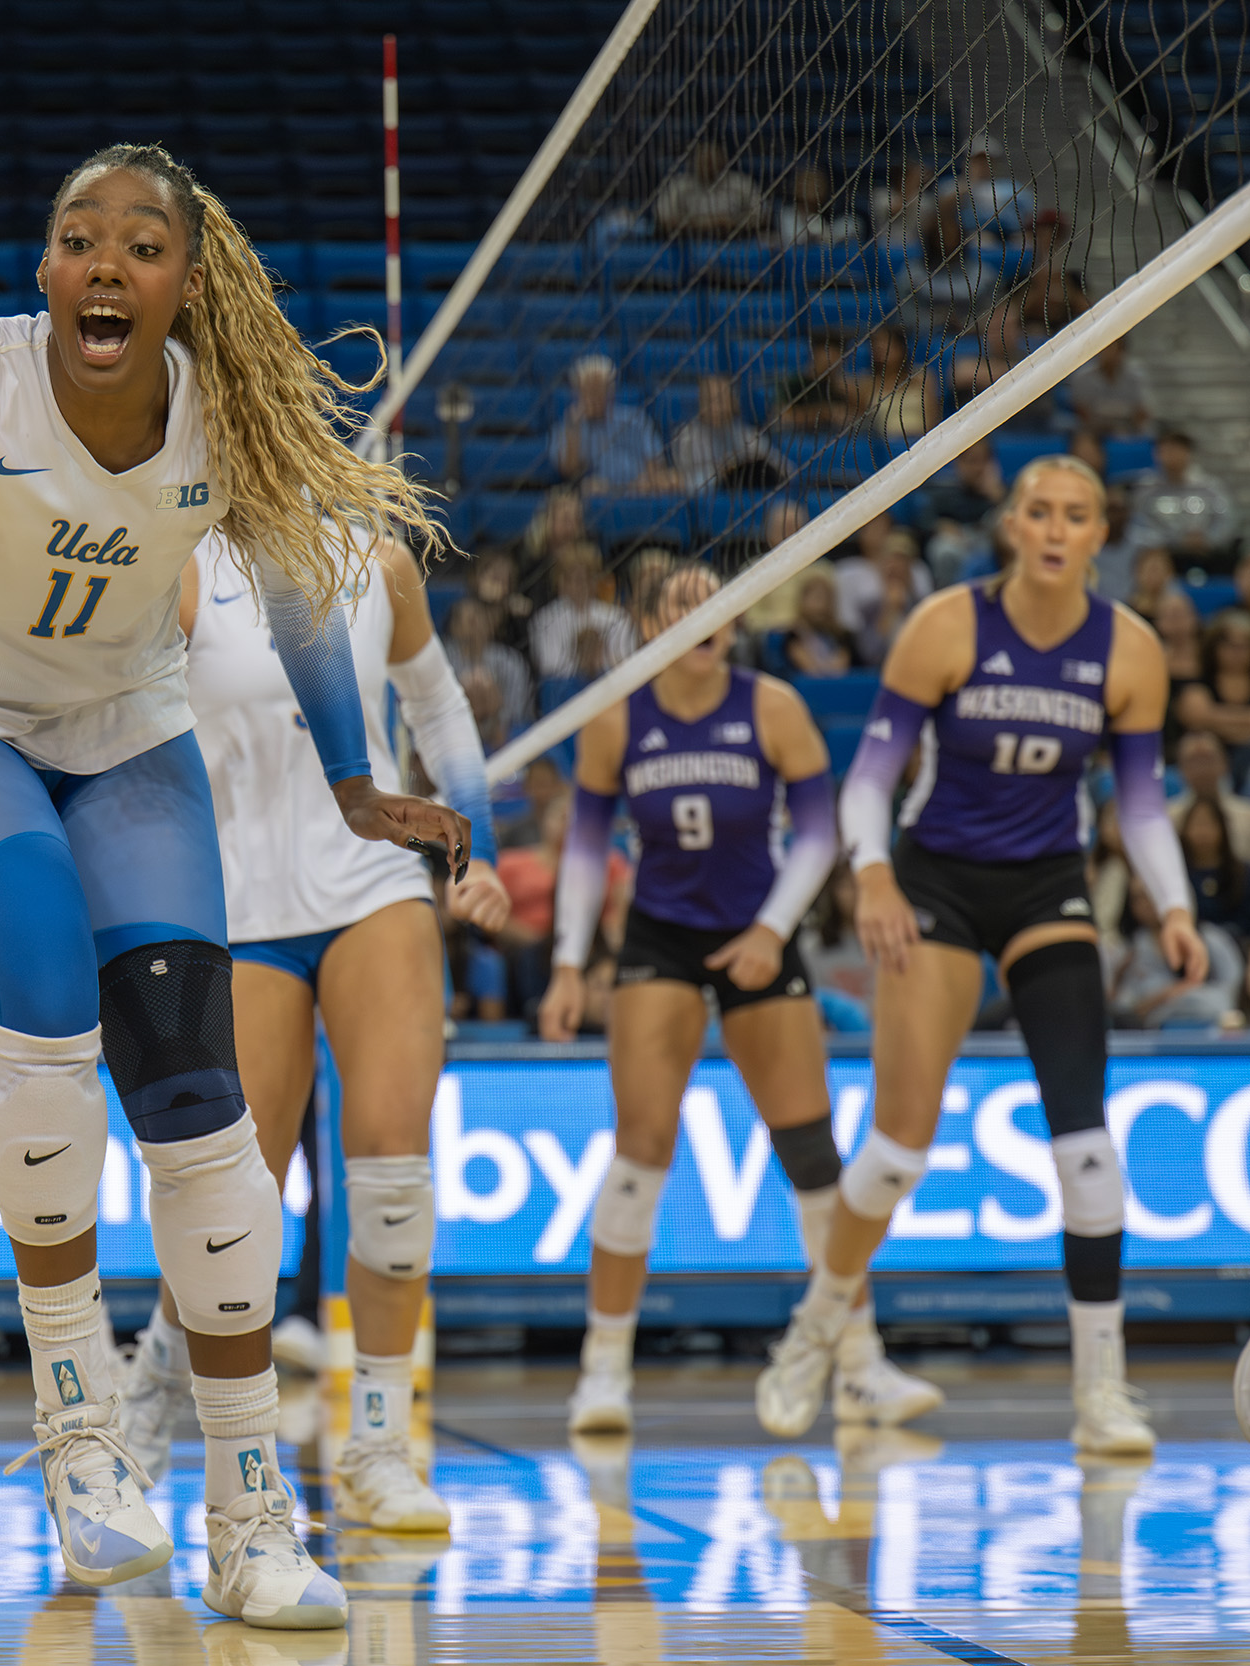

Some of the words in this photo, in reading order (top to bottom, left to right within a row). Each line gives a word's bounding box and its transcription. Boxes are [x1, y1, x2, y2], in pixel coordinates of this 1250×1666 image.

[46, 518, 140, 567] Ucla
[27, 567, 112, 640] 11
[956, 684, 1105, 735] WASHINGTON
[625, 750, 760, 798] WASHINGTON
[991, 731, 1063, 775] 10
[671, 793, 714, 850] 9
[434, 1072, 616, 1263] by
[61, 1417, 84, 1433] NIKE
